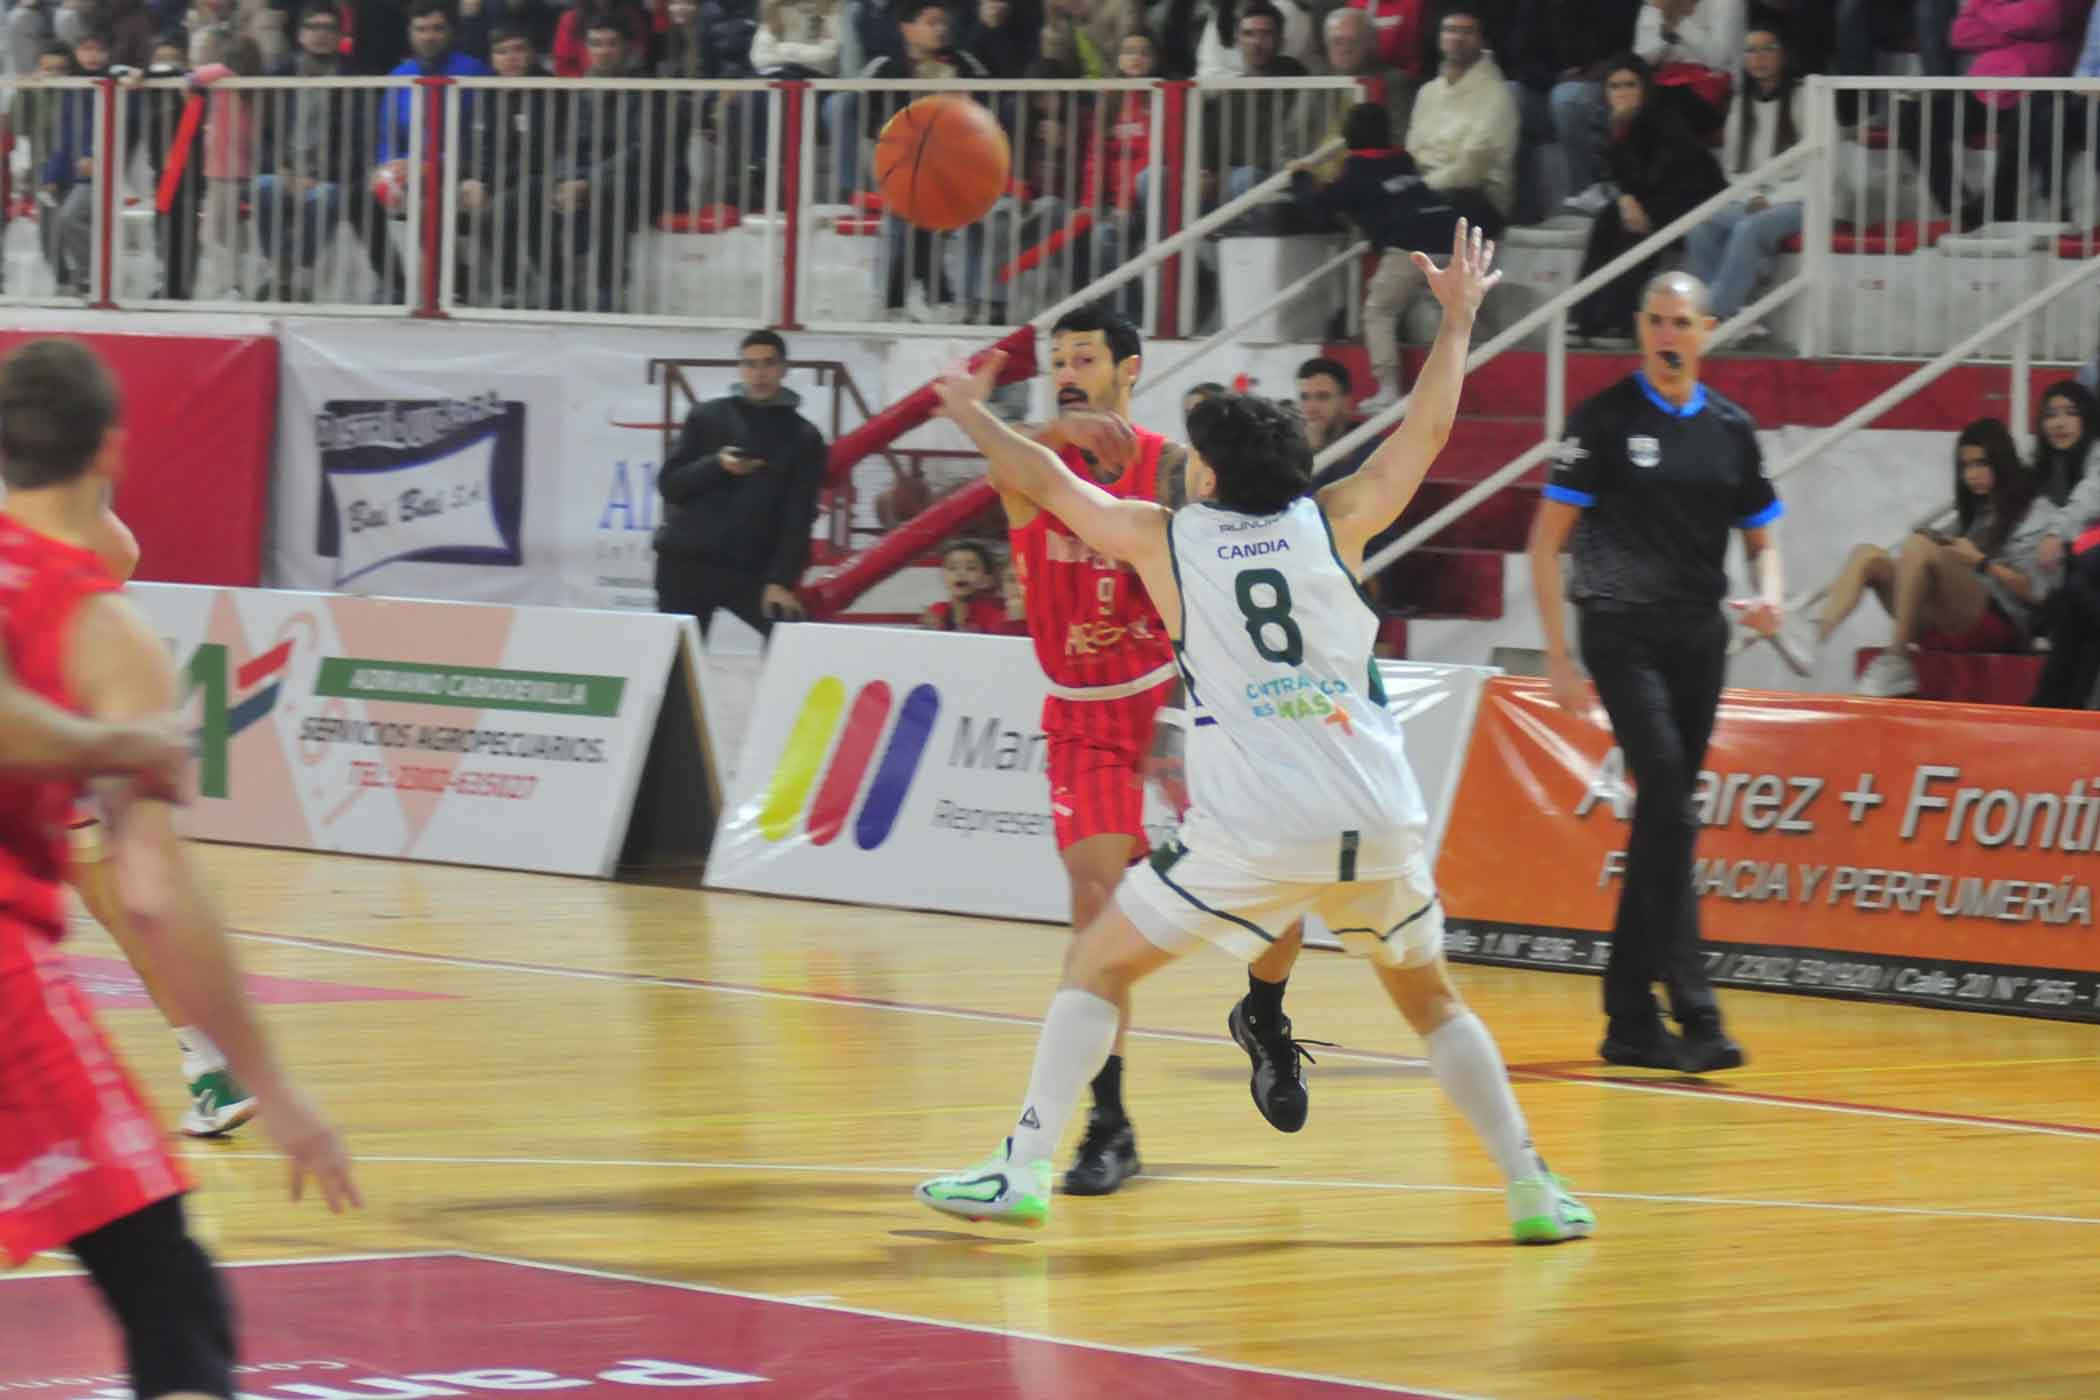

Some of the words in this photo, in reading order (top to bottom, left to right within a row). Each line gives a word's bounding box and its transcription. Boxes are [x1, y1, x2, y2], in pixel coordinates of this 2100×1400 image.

[1216, 538, 1290, 560] CANDIA
[1096, 576, 1116, 616] 9
[1234, 567, 1304, 667] 8
[299, 716, 412, 748] SERVICIOS
[1574, 745, 1825, 833] Aarez
[1795, 863, 1829, 904] Y
[1827, 865, 2093, 926] PERFUMERÍA
[1893, 966, 1957, 995] Calle
